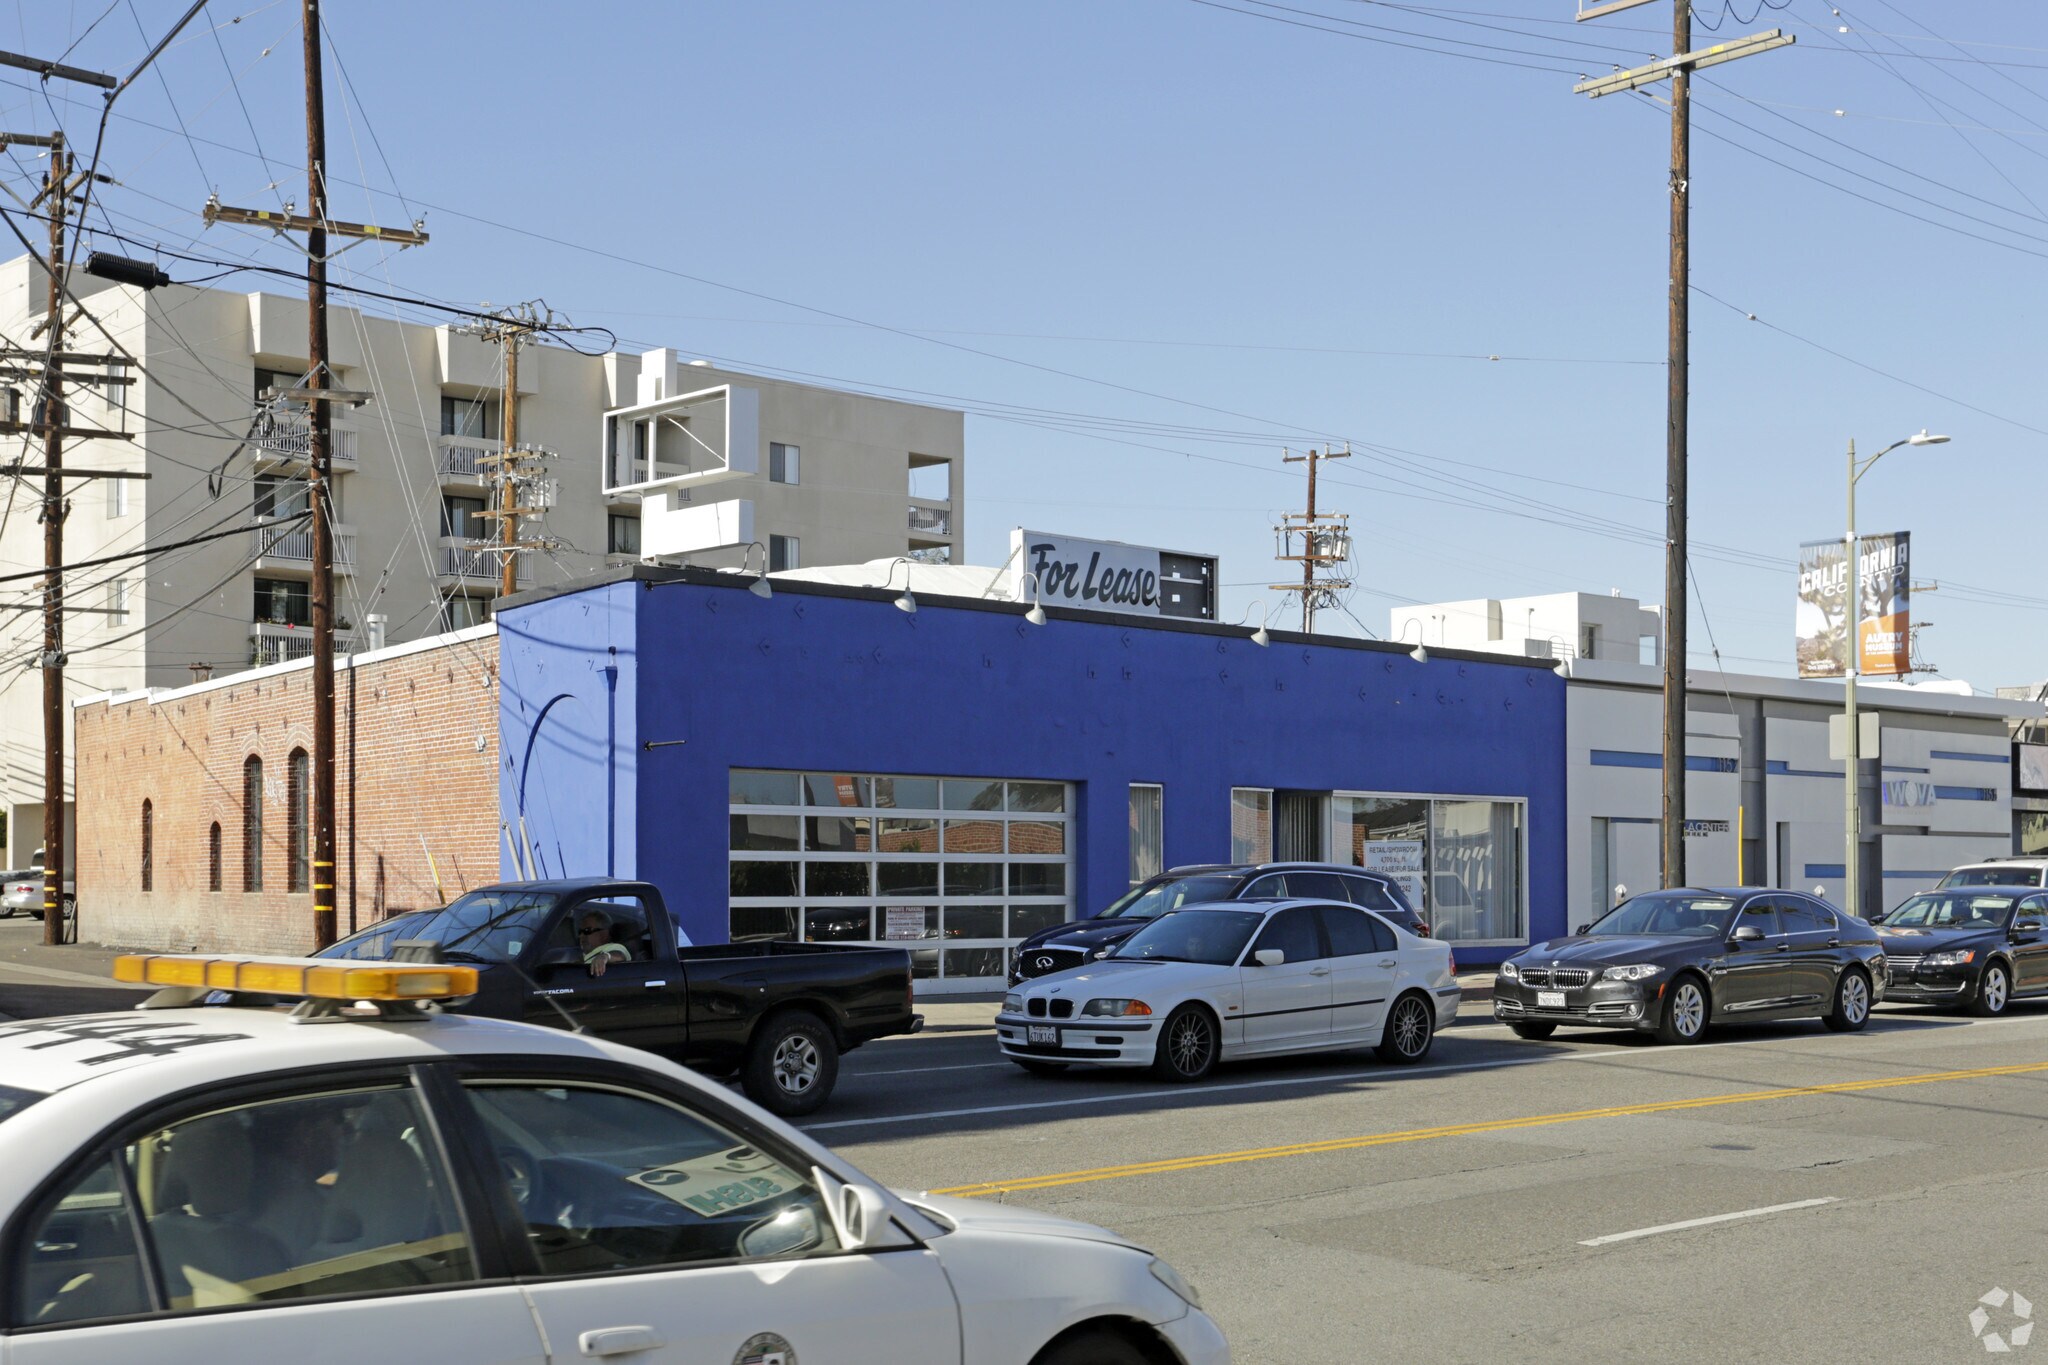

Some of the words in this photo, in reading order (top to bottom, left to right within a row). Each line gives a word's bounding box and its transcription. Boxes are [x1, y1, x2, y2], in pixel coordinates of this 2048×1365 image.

[1030, 543, 1079, 598] For
[1081, 551, 1160, 607] Lease
[1865, 631, 1903, 643] AUTRY
[1865, 641, 1903, 652] MUSEUM
